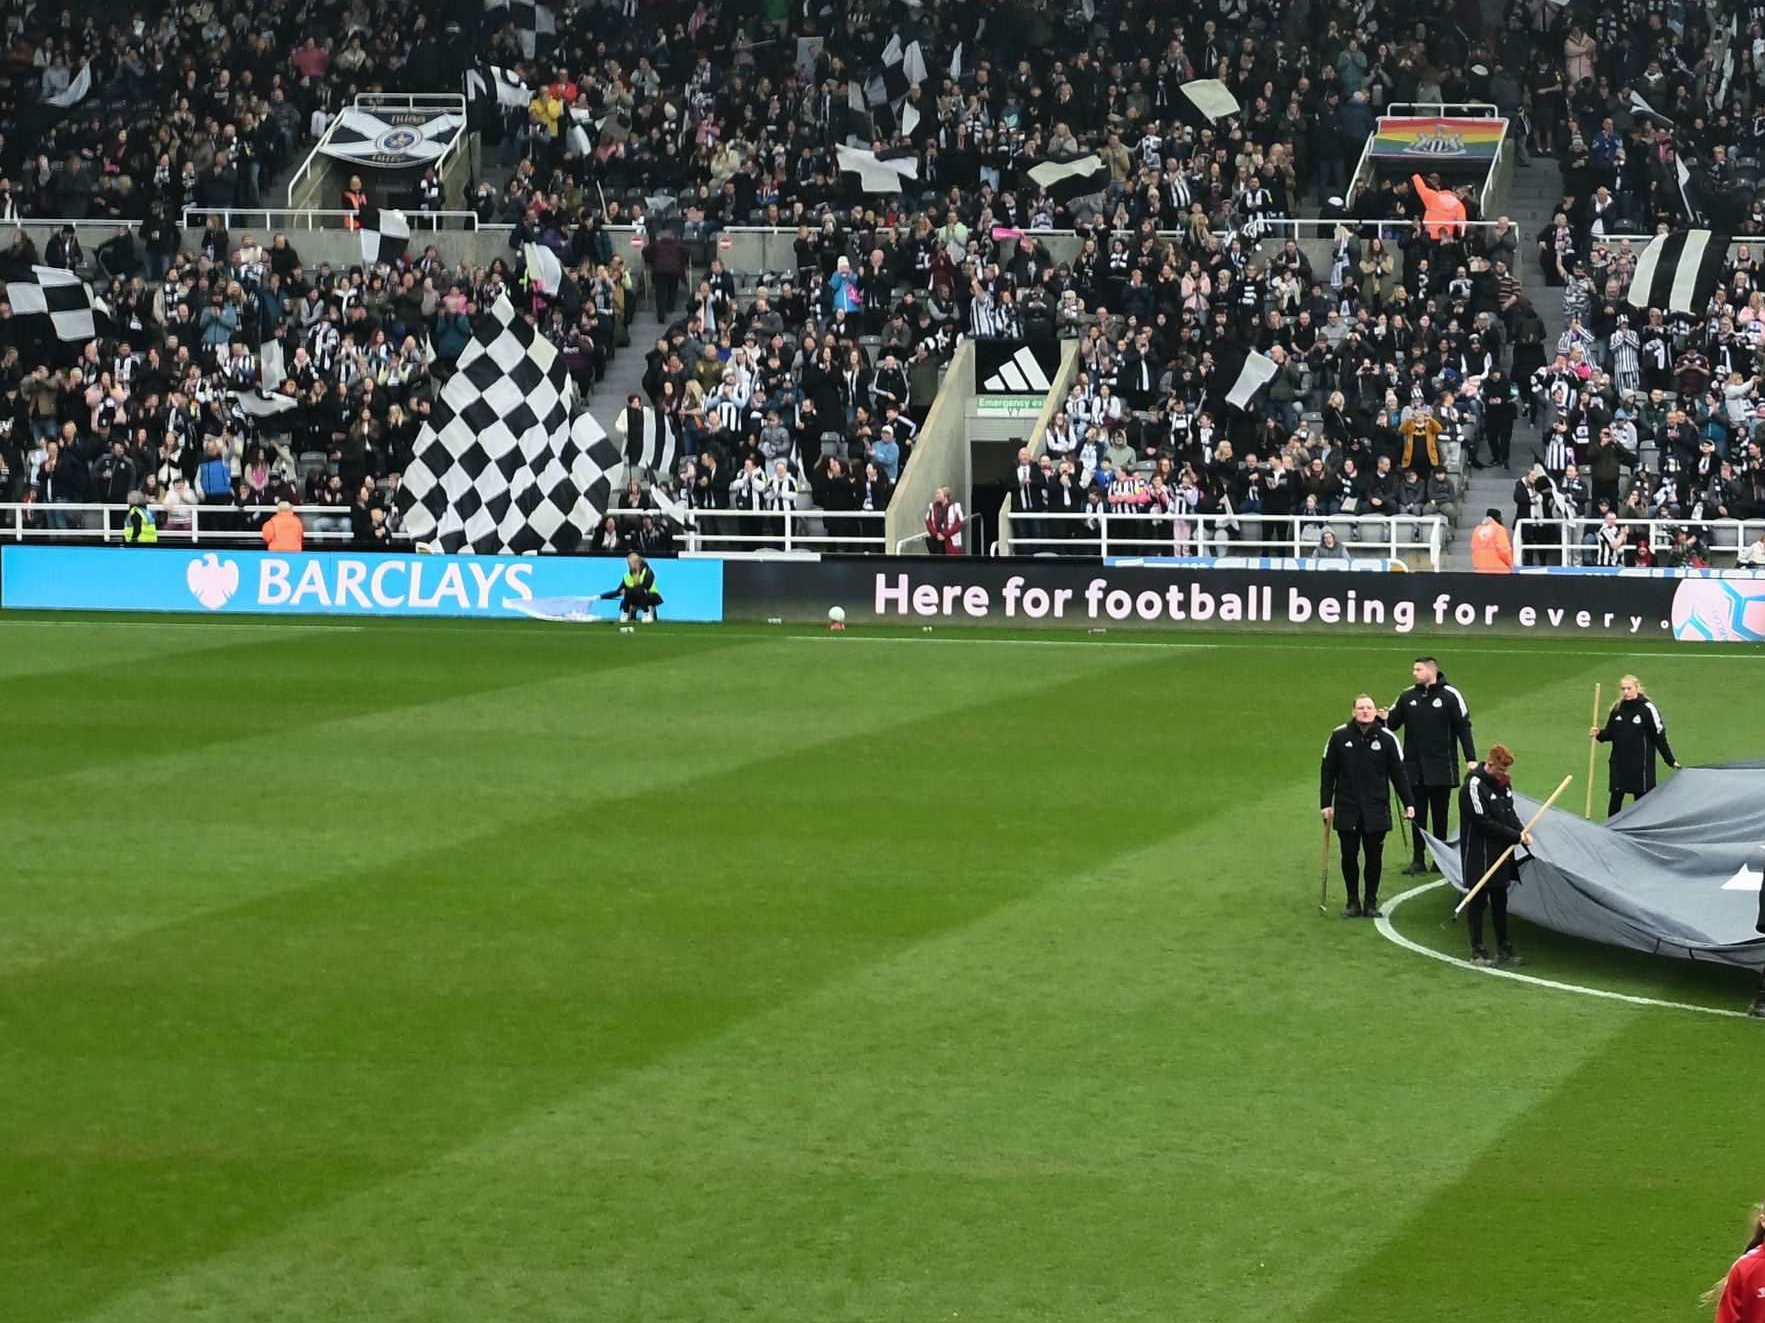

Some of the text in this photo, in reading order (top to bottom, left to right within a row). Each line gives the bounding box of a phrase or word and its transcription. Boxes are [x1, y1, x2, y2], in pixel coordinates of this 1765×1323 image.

[979, 399, 1030, 408] Emergency
[258, 559, 533, 610] BARCLAYS
[875, 574, 988, 616] Here
[1003, 577, 1072, 617] for
[1084, 578, 1272, 621] football
[1289, 588, 1415, 632] being
[1433, 594, 1498, 625] for
